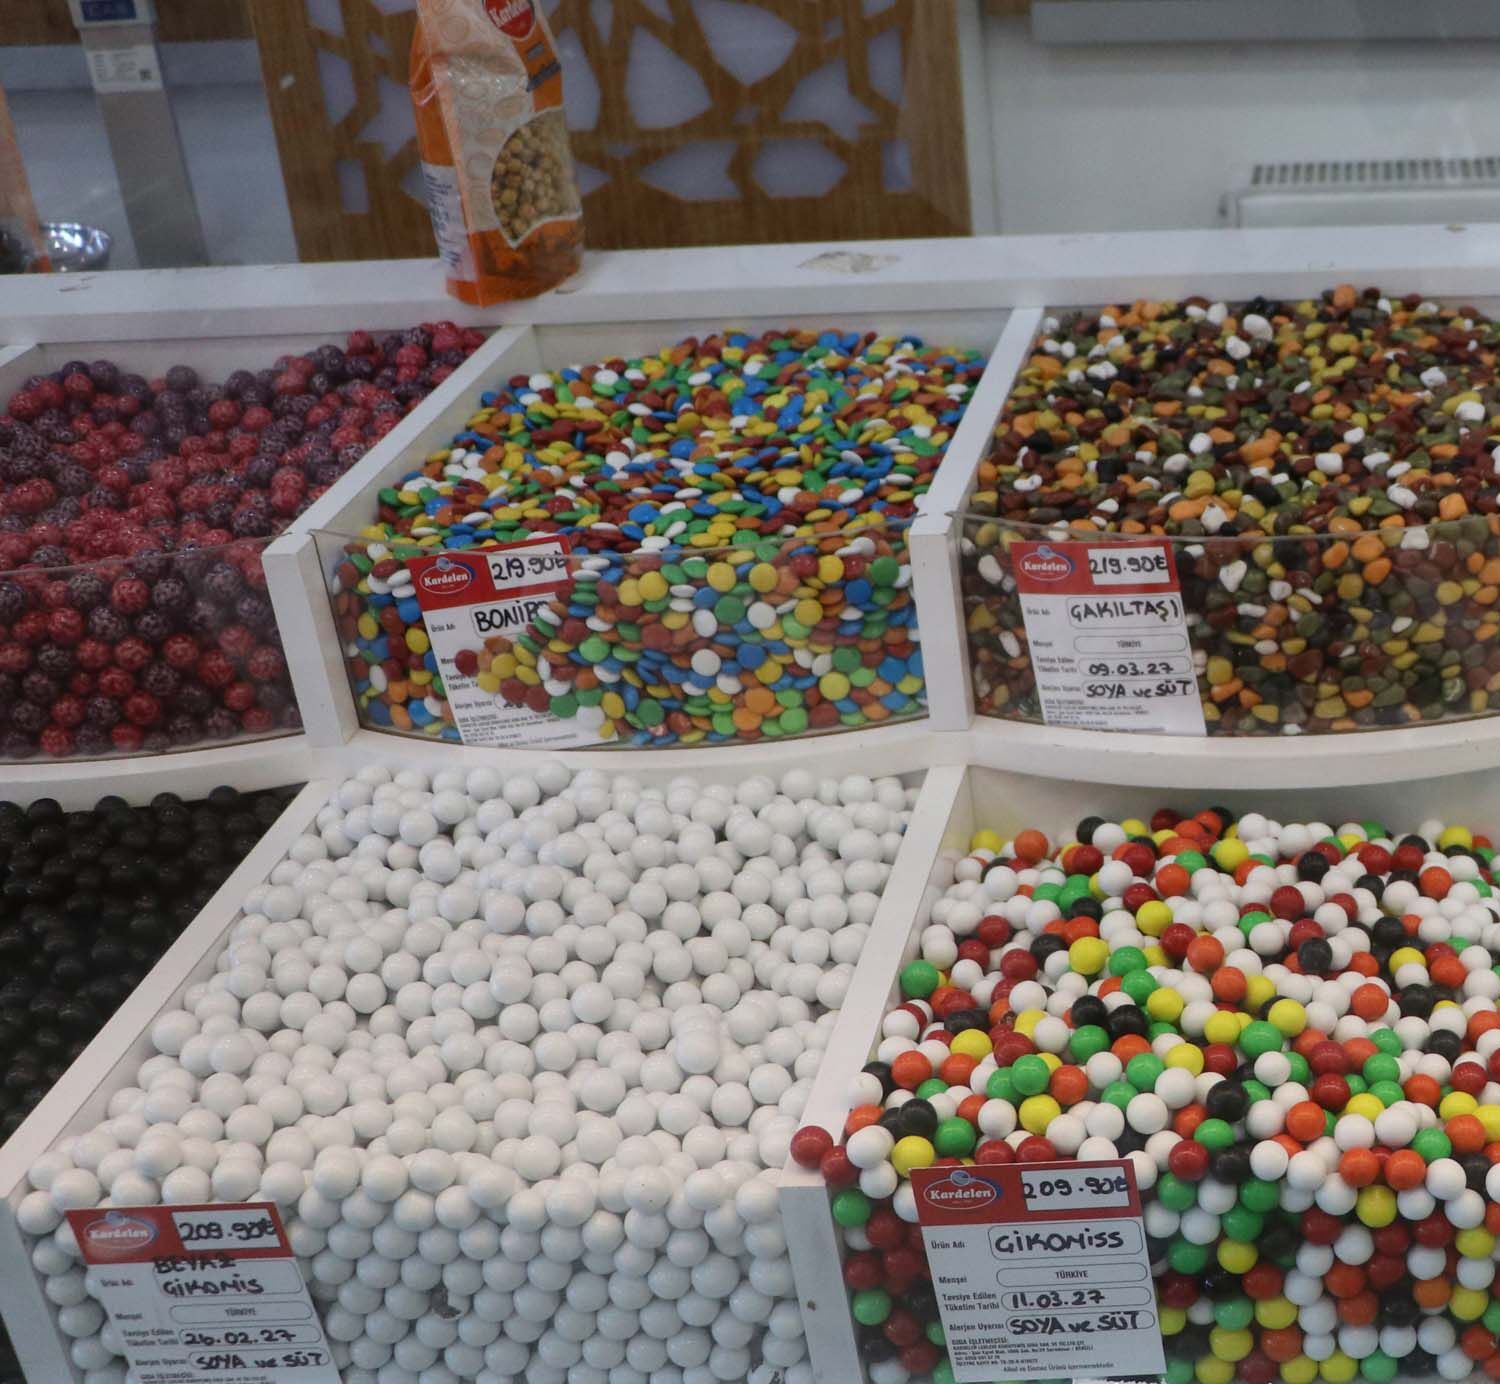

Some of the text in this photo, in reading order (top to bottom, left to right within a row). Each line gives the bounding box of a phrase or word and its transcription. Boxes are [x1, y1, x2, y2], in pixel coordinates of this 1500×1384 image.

[1024, 560, 1068, 572] Kardelen
[424, 572, 469, 587] Kardelen
[1086, 683, 1126, 699] SOYA
[1155, 680, 1192, 697] SÜT
[929, 1188, 992, 1200] Kardelen
[1011, 1289, 1105, 1309] 11.03.27
[1009, 1316, 1066, 1335] SOYA
[1097, 1310, 1139, 1330] SÜT
[196, 1353, 248, 1370] SOYA
[282, 1350, 323, 1368] SÜT
